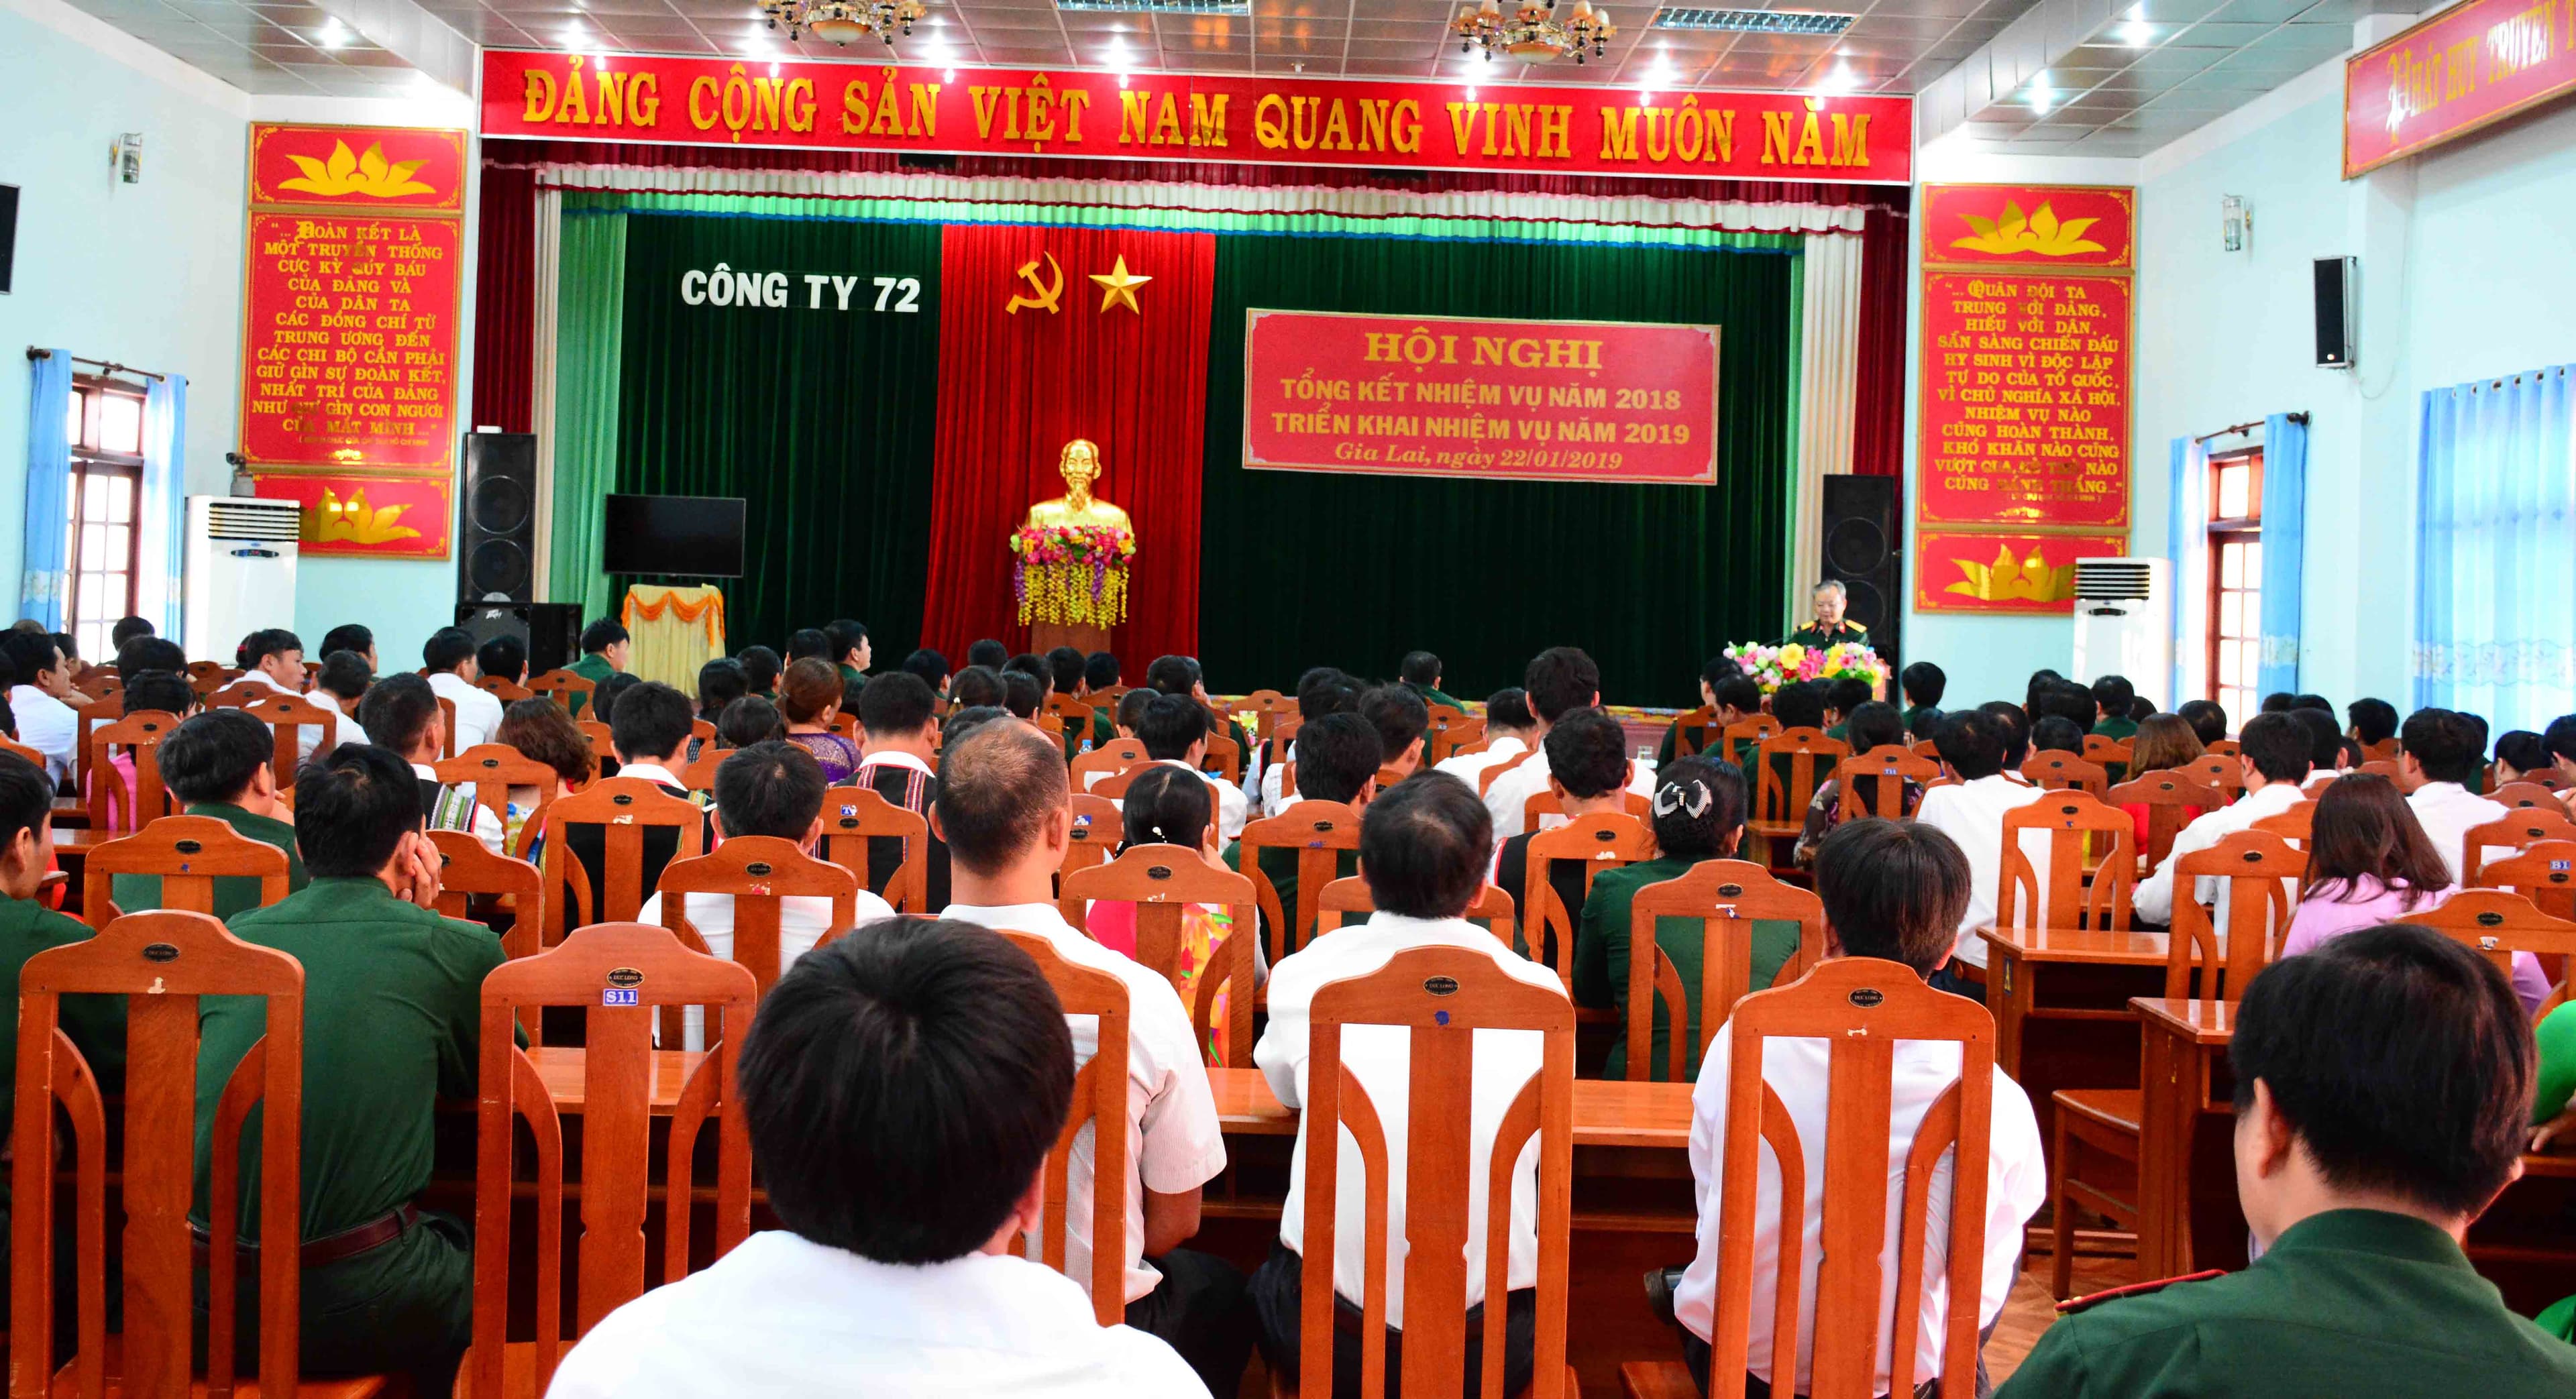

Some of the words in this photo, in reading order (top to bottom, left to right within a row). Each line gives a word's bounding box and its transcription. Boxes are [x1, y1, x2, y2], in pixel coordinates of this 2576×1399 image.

[523, 55, 661, 127] ĐẢNG
[688, 63, 818, 143] CỘNG
[843, 66, 941, 137] SẢN
[969, 72, 1092, 152] VIỆT
[1119, 90, 1230, 147] NAM
[1254, 93, 1424, 154] QUANG
[1445, 102, 1576, 159] VINH
[1599, 95, 1736, 164] MUÔN
[1760, 95, 1872, 168] NĂM
[356, 221, 392, 241] KẾT
[399, 225, 421, 241] LÀ
[264, 239, 300, 258] MỘT
[307, 240, 376, 258] TRUYỀN
[388, 242, 443, 260] THỐNG
[278, 258, 311, 275] CỰC
[319, 258, 343, 274] KỲ
[394, 260, 426, 277] BÁU
[288, 274, 321, 291] CỦA
[332, 276, 380, 292] ĐẢNG
[390, 277, 412, 294] VÀ
[680, 261, 789, 311] CÔNG
[804, 272, 860, 313] TY
[873, 274, 921, 315] 72
[2027, 283, 2055, 300] ĐỘI
[2065, 286, 2086, 299] TA
[296, 292, 329, 309] CỦA
[341, 294, 378, 311] DÂN
[389, 298, 411, 312] TA
[1952, 301, 2007, 314] TRUNG
[2018, 299, 2044, 315] VỚI
[276, 310, 309, 327] CÁC
[321, 310, 366, 328] ĐỒNG
[376, 314, 407, 329] CHÍ
[415, 313, 437, 329] TỪ
[1966, 314, 2006, 332] HIẾU
[2017, 316, 2044, 333] VỚI
[274, 329, 329, 344] TRUNG
[341, 332, 384, 346] ƯƠNG
[395, 330, 430, 347] ĐẾN
[1937, 331, 1972, 348] SẴN
[1979, 333, 2023, 350] SÀNG
[2029, 333, 2082, 351] CHIẾN
[2088, 334, 2120, 353] ĐẤU
[258, 344, 290, 361] CÁC
[297, 349, 327, 362] CHI
[335, 347, 358, 366] BỘ
[364, 347, 398, 364] CẦN
[405, 349, 445, 366] PHẢI
[1363, 326, 1460, 373] HỘI
[1470, 336, 1603, 378] NGHỊ
[1944, 353, 1968, 366] HY
[1974, 353, 2012, 367] SINH
[2019, 351, 2035, 368] VÌ
[2041, 354, 2074, 370] ĐỘC
[2082, 355, 2114, 370] LẬP
[256, 363, 284, 378] GIỮ
[290, 363, 319, 380] GÌN
[325, 366, 347, 382] SỰ
[355, 366, 400, 382] ĐOÀN
[1946, 369, 1969, 386] TỰ
[1978, 372, 2000, 385] DO
[2006, 369, 2039, 386] CỦA
[2045, 369, 2065, 386] TỔ
[260, 378, 306, 397] NHẤT
[316, 382, 345, 398] TRÍ
[352, 382, 384, 399] CỦA
[394, 383, 439, 400] ĐẢNG
[1279, 366, 1350, 401] TỔNG
[1358, 372, 1409, 403] KẾT
[1415, 378, 1501, 409] NHIỆM
[1509, 384, 1543, 414] VỤ
[1547, 382, 1607, 410] NĂM
[1614, 388, 1682, 411] 2018
[1937, 384, 1956, 402] VÌ
[1960, 386, 1996, 402] CHỦ
[252, 400, 288, 414] NHƯ
[325, 400, 353, 416] GÌN
[360, 404, 392, 416] CON
[396, 404, 443, 418] NGƯƠI
[1965, 404, 2020, 423] NHIỆM
[2027, 408, 2050, 424] VỤ
[2058, 406, 2092, 422] NÀO
[327, 416, 362, 434] MẮT
[1271, 402, 1350, 436] TRIỂN
[1356, 415, 1419, 437] KHAI
[1424, 412, 1511, 444] NHIỆM
[1517, 420, 1553, 447] VỤ
[1557, 418, 1617, 443] NĂM
[1623, 422, 1690, 445] 2019
[1942, 421, 1987, 437] CŨNG
[1996, 421, 2041, 439] HOÀN
[1334, 441, 1380, 463] Gia
[1385, 442, 1432, 466] Lai,
[1436, 445, 1496, 469] ngày
[1499, 449, 1623, 471] 22/01/2019
[1943, 438, 1979, 454] KHÓ
[1987, 439, 2036, 455] KHĂN
[2041, 441, 2072, 457] NÀO
[2077, 443, 2120, 458] CŨNG
[1935, 459, 1977, 474] VƯỢT
[2086, 459, 2118, 475] NÀO
[1945, 475, 1989, 490] CŨNG
[606, 991, 636, 1003] S11
